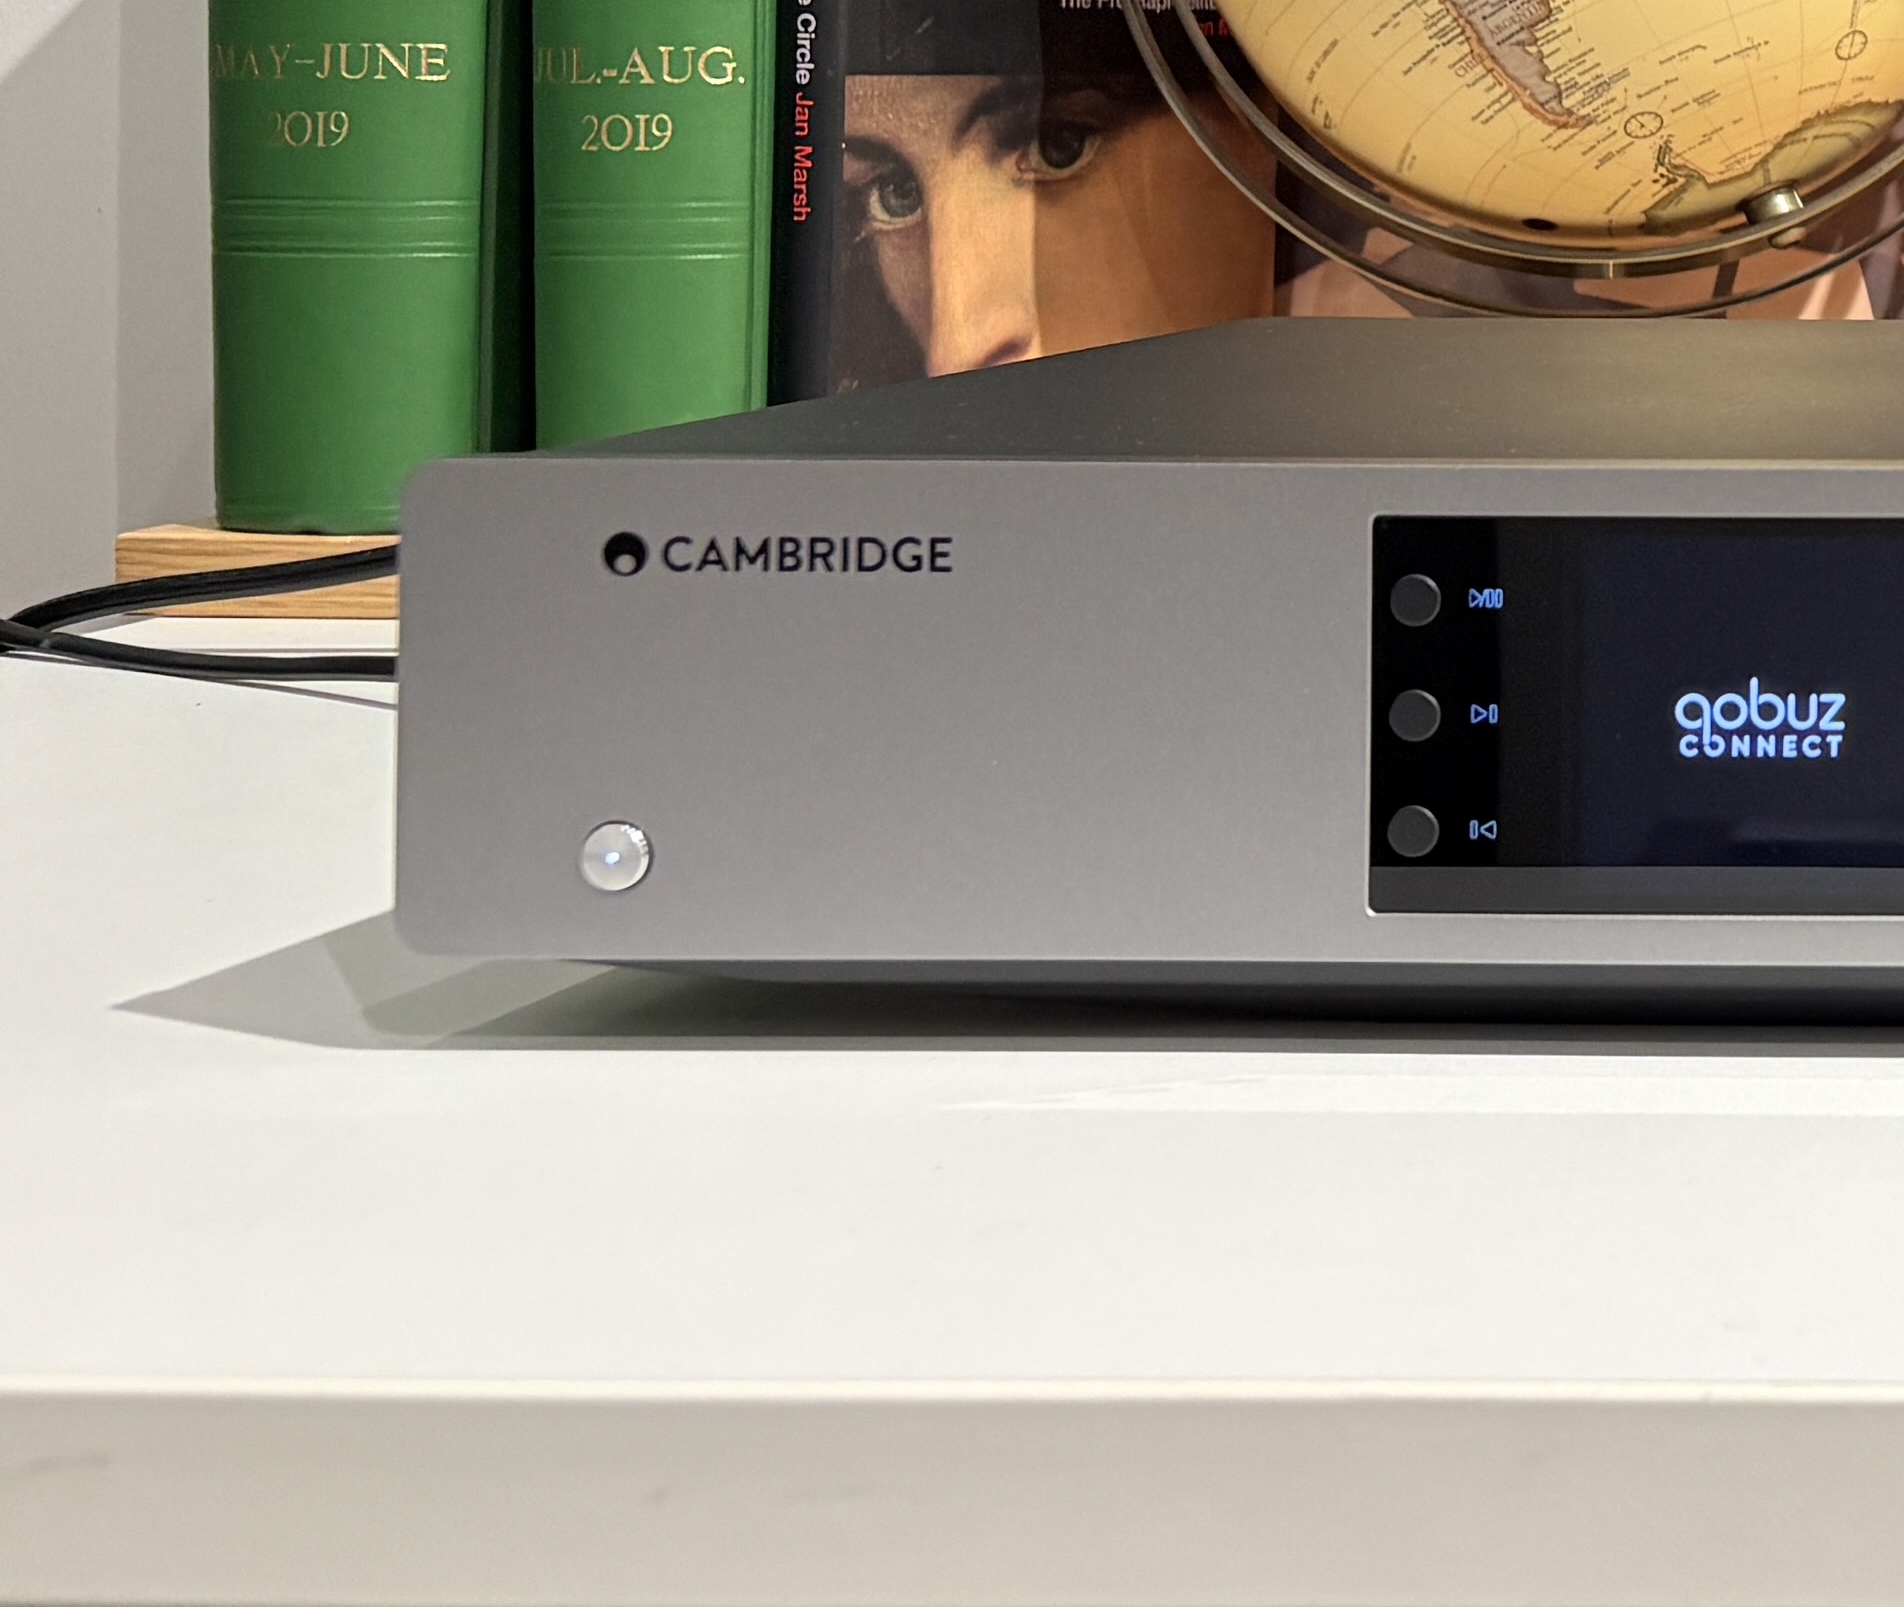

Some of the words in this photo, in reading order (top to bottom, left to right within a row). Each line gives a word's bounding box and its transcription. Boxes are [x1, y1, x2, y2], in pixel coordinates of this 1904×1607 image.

[793, 12, 817, 85] Circle
[268, 111, 350, 148] 2019
[581, 113, 673, 151] 2019
[792, 91, 815, 136] Jan
[790, 144, 814, 222] Marsh
[662, 536, 953, 573] CAMBRIDGE
[1679, 734, 1843, 758] CONNECT
